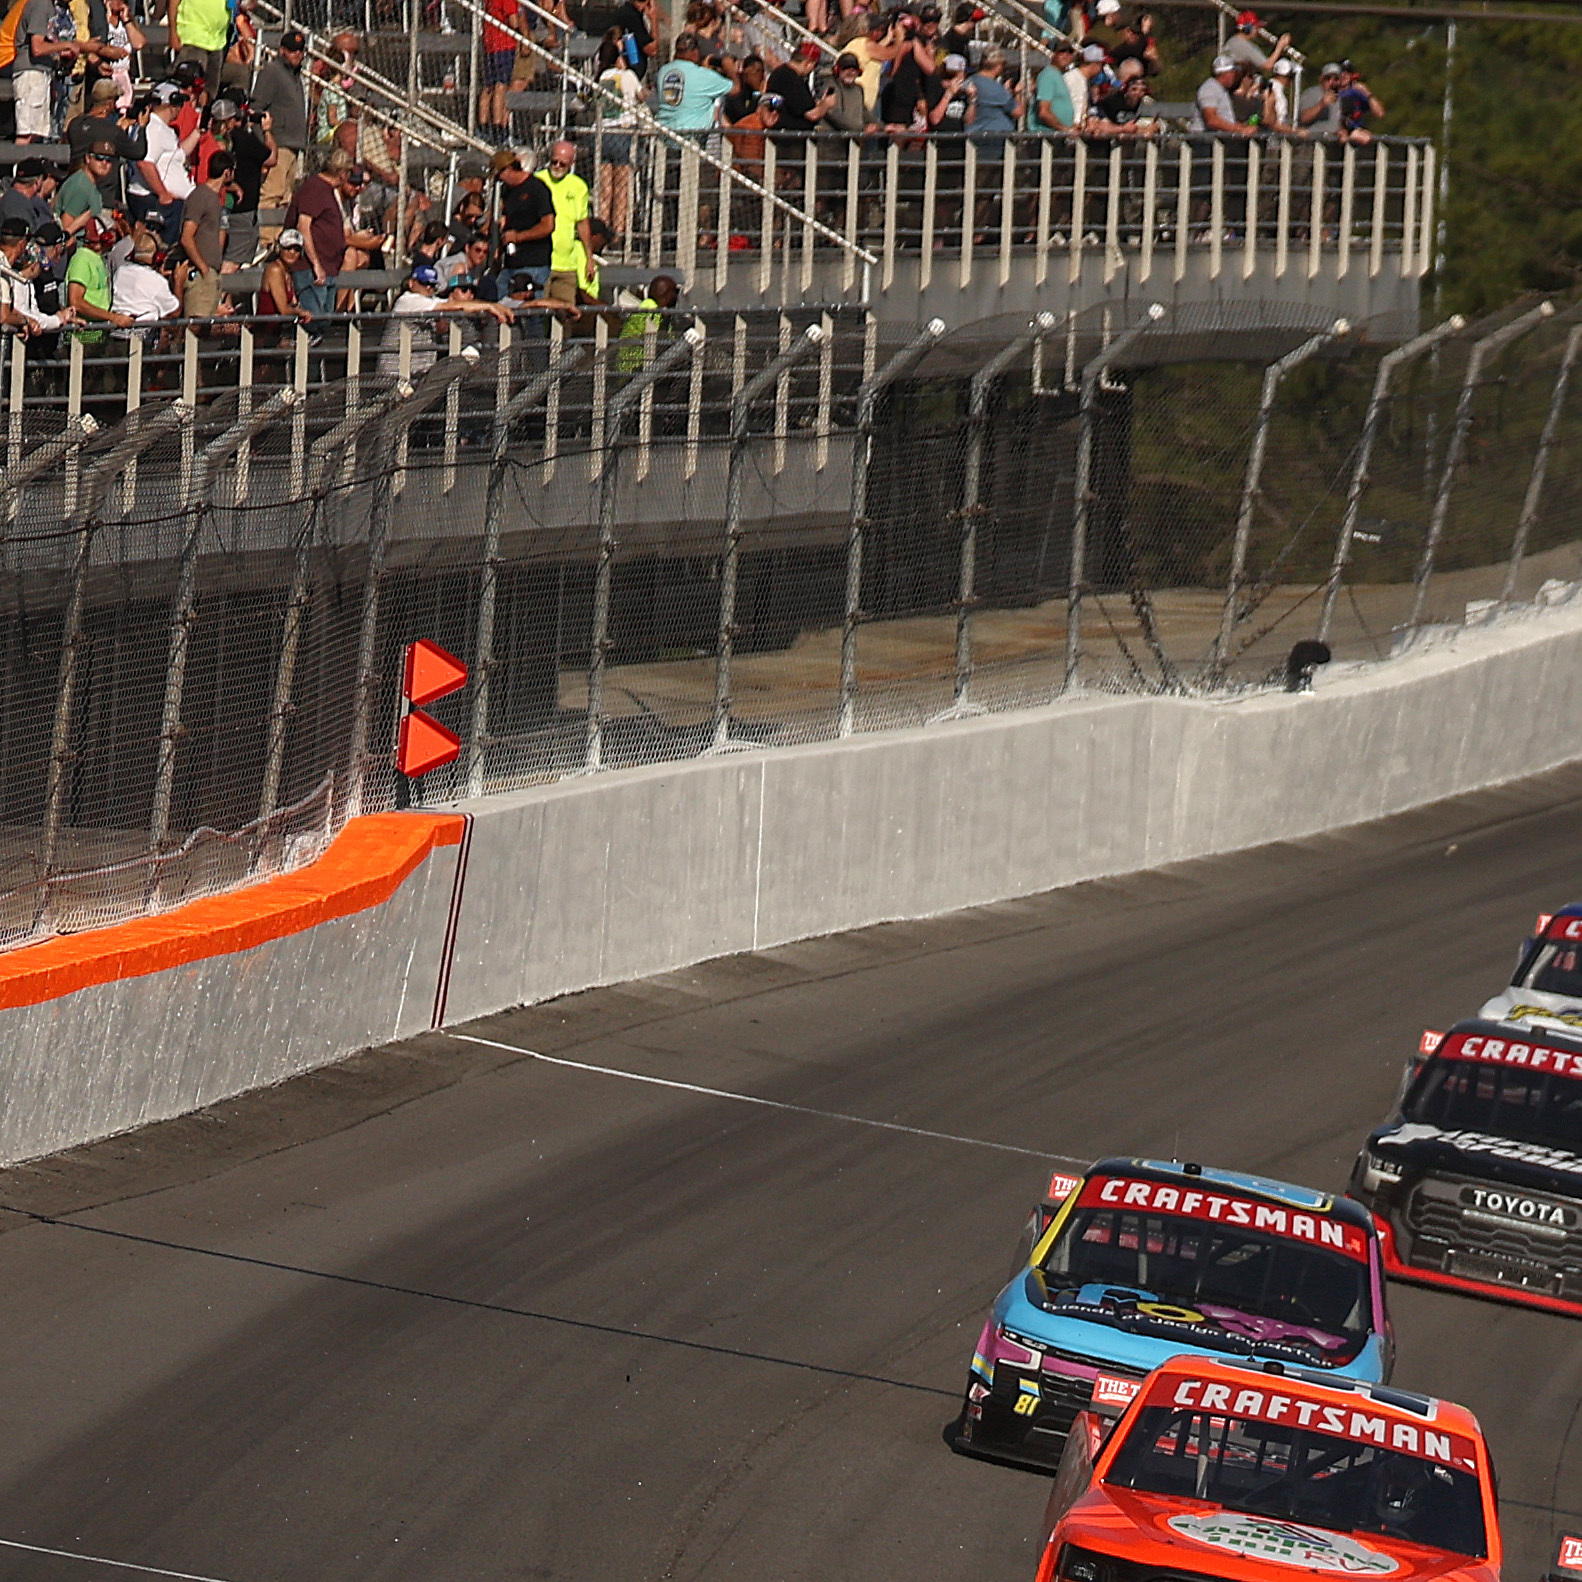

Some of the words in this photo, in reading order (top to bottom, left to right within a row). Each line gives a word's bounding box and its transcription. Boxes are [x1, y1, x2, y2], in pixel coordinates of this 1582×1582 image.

[1100, 1179, 1343, 1248] CRAFTSMAN
[1472, 1190, 1567, 1225] TOYOTA
[1099, 1377, 1129, 1394] THE
[1013, 1393, 1041, 1417] 81
[1173, 1381, 1451, 1462] CRAFTSMAN
